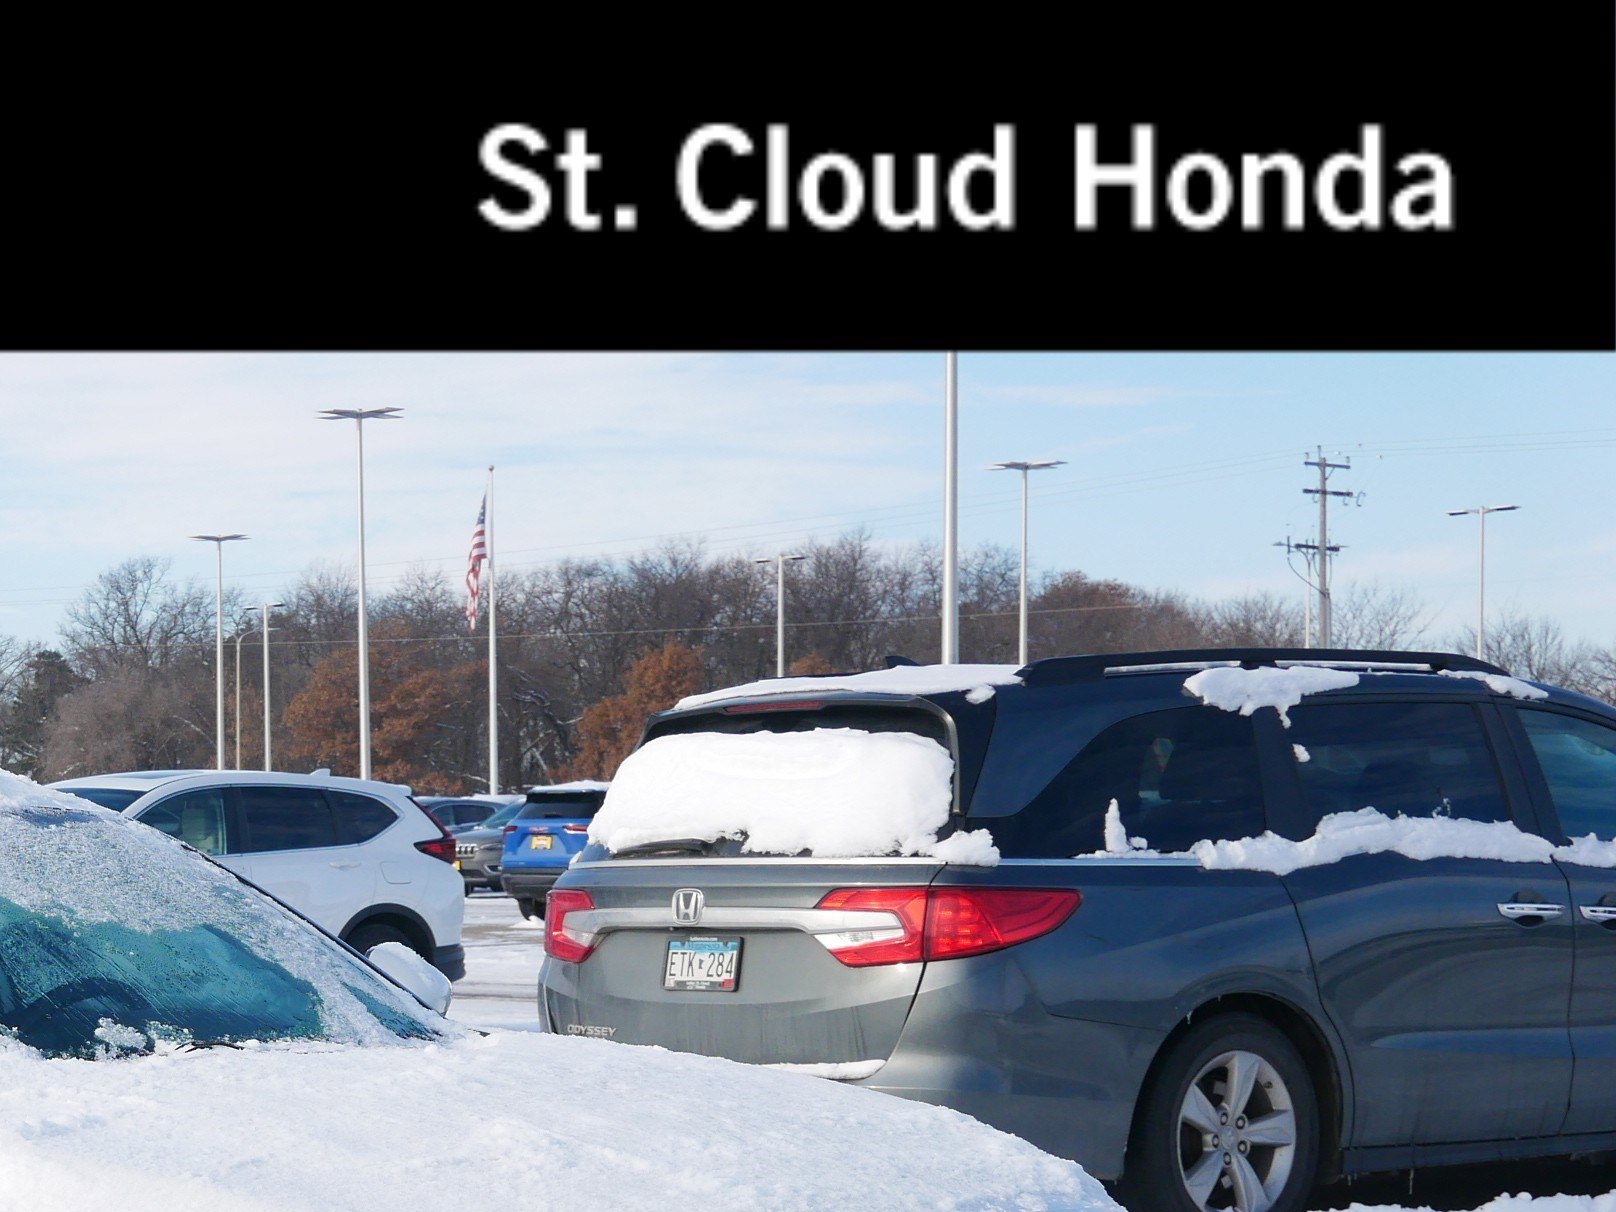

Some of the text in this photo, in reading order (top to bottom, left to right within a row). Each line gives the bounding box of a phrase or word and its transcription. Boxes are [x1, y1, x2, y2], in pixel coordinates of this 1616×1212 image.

[668, 951, 735, 978] ETK 284
[567, 1024, 616, 1037] ODYSSEY
